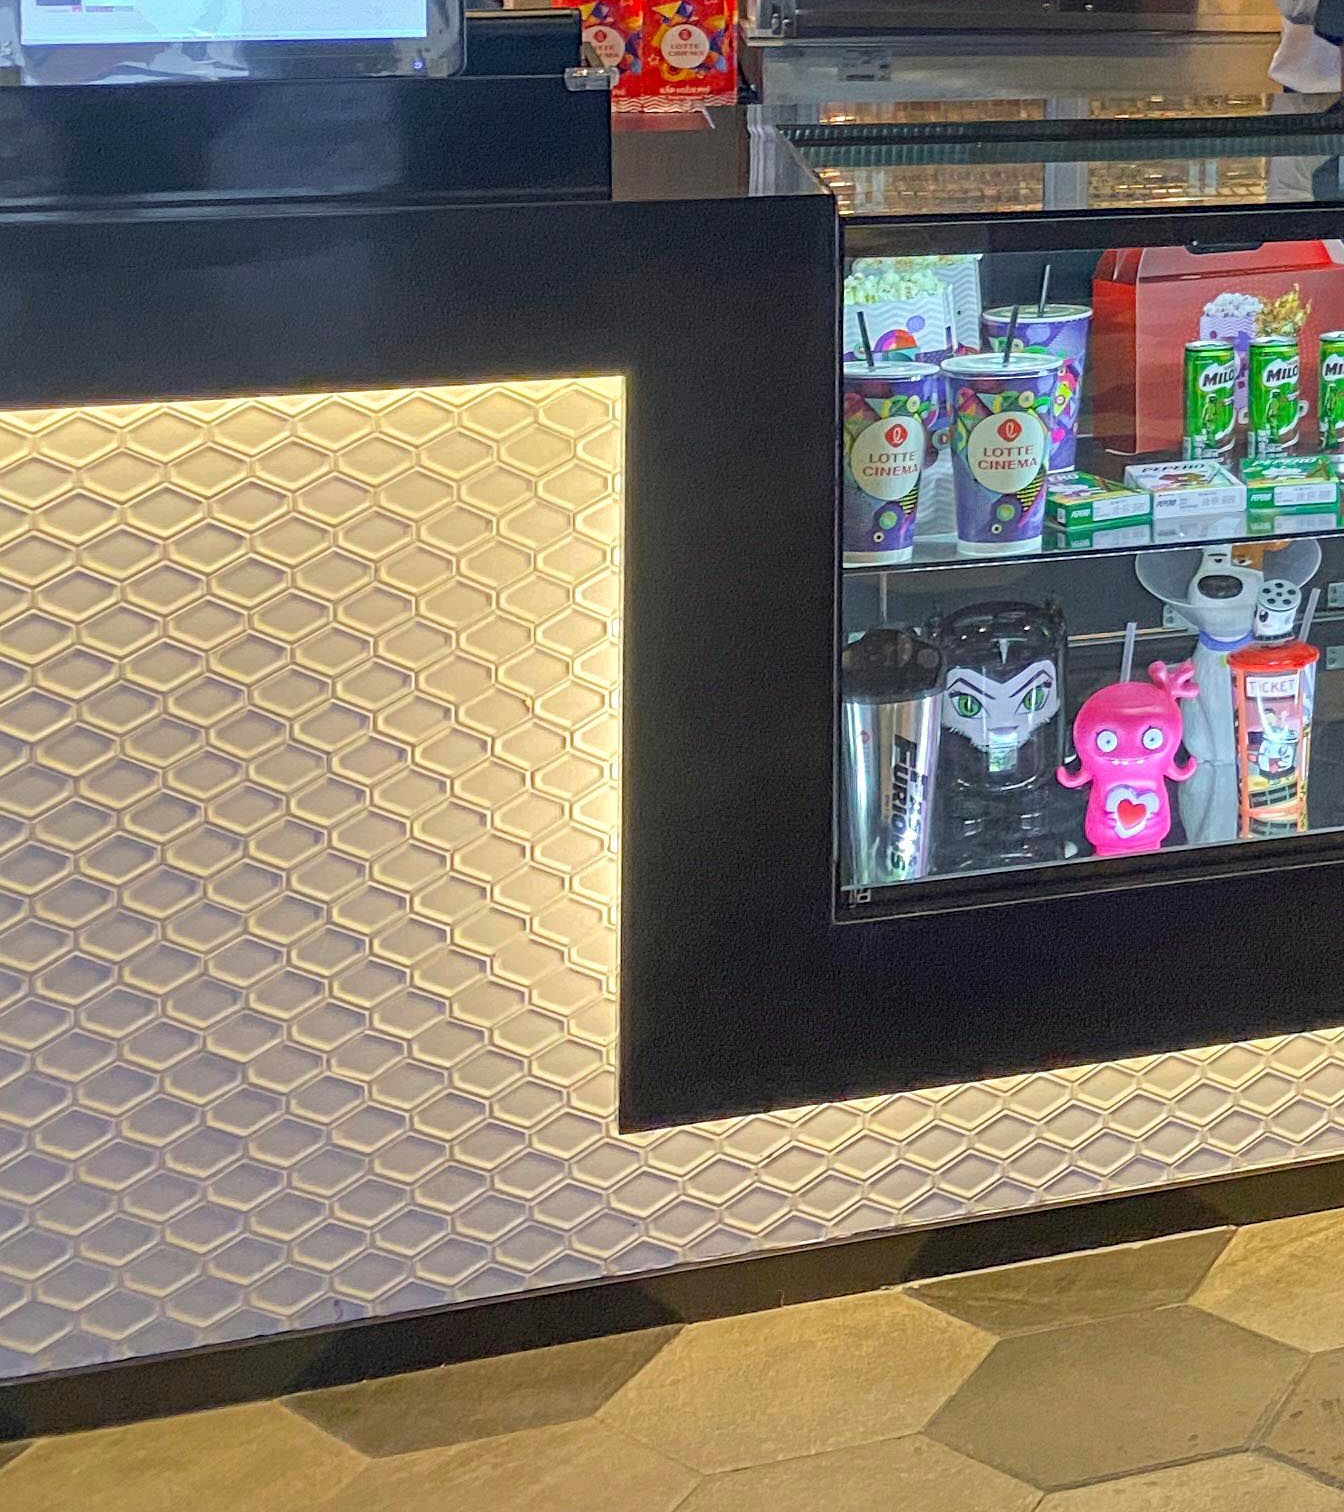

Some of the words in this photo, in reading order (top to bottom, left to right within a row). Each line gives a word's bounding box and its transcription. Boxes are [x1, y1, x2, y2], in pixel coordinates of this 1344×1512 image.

[1202, 369, 1236, 388] MILO
[1266, 364, 1299, 383] MILO
[869, 449, 915, 464] LOTTE
[983, 444, 1034, 458] LOTTE
[862, 464, 919, 478] CINEMA
[977, 457, 1037, 470] CINEMA
[1249, 678, 1296, 694] TICKET
